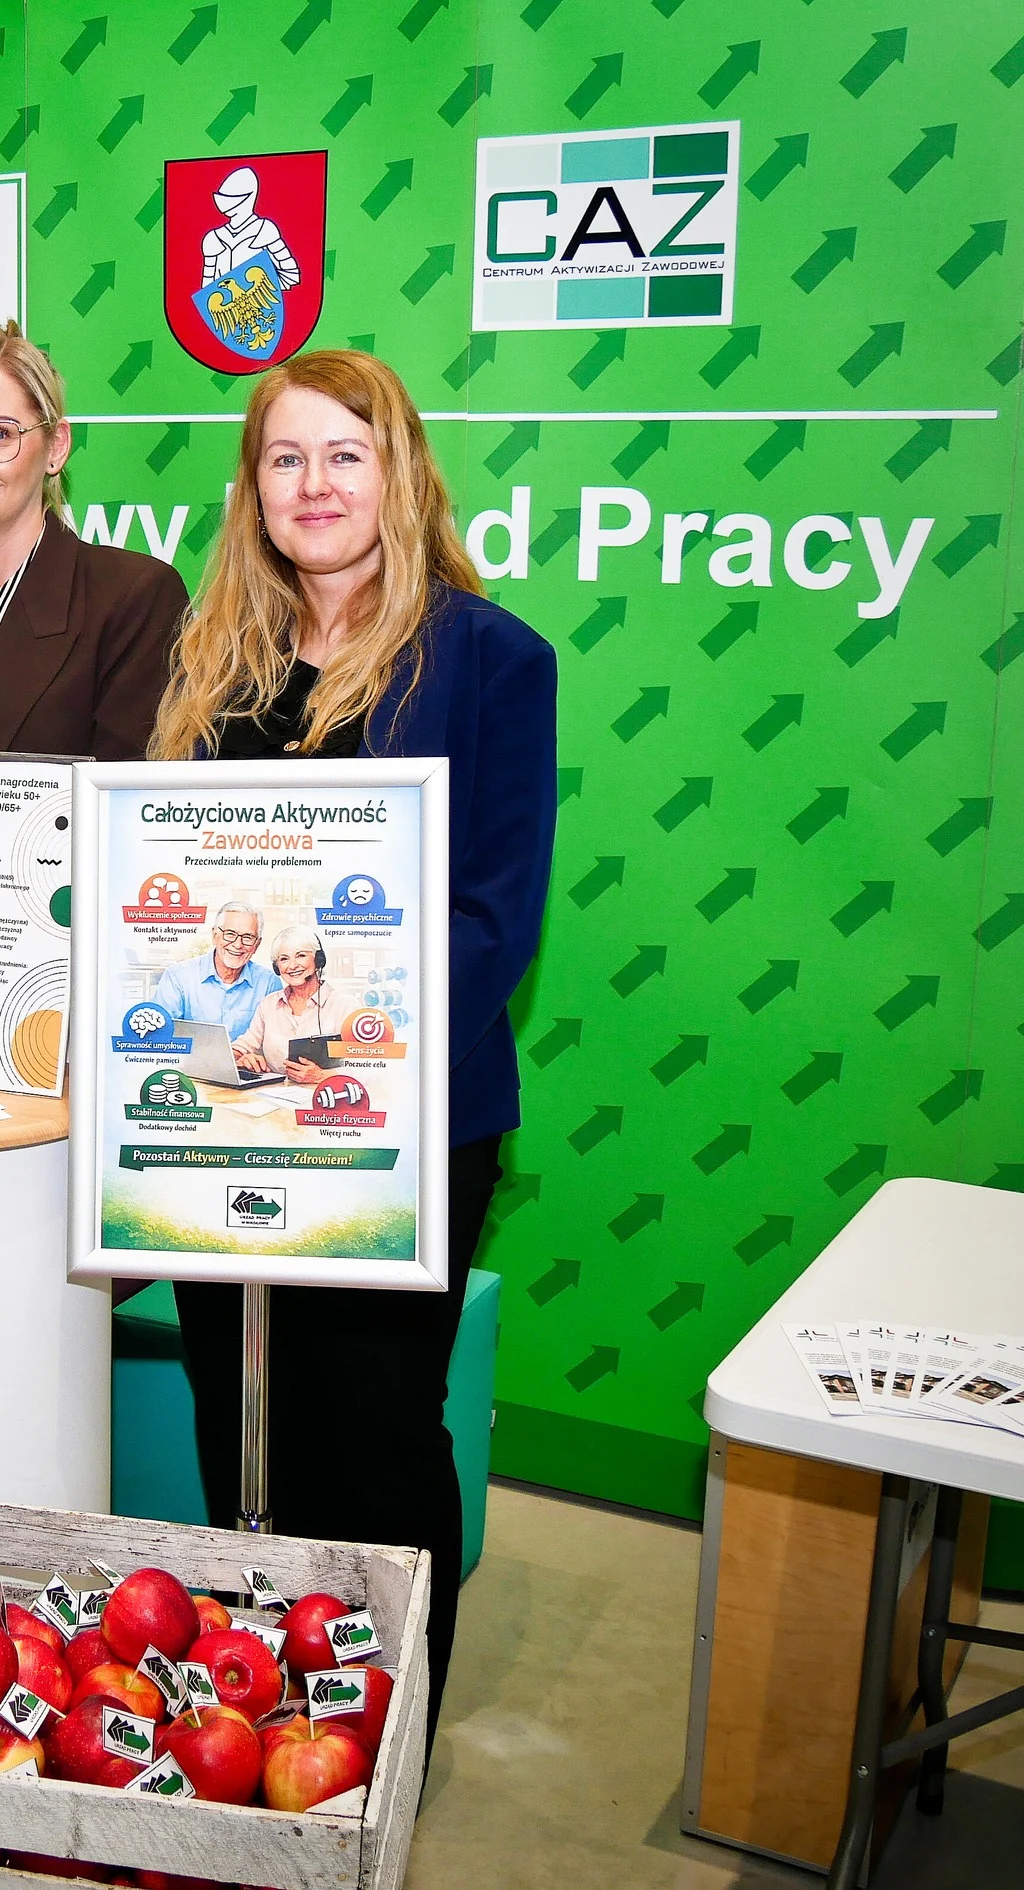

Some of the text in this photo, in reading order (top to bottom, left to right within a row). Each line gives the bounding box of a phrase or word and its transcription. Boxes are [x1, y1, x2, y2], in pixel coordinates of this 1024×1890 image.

[486, 179, 725, 263] CAZ
[577, 486, 936, 619] Pracy
[23, 791, 40, 800] 50+
[140, 799, 387, 830] Całożyciowa Aktywność
[202, 829, 314, 850] Zawodowa
[184, 856, 322, 868] Przeciwdziała wielu problemom
[126, 910, 202, 921] Wykluczenie społeczne
[320, 912, 393, 924] Zdrowie psychiczne
[133, 926, 158, 934] Kontakt
[164, 926, 198, 936] aktywność
[347, 929, 392, 938] samopoczucie
[148, 934, 178, 944] społeczna
[116, 1040, 187, 1052] Sprawność umysłowa
[346, 1046, 385, 1057] Sens życia
[124, 1054, 180, 1065] Ćwiczenie pamięci
[344, 1060, 386, 1068] Poczucie celu
[130, 1107, 205, 1118] Stabilność finansowa
[304, 1113, 376, 1126] Kondycja fizyczna
[138, 1123, 197, 1132] Dodatkowy dochód
[320, 1128, 362, 1138] Więcej ruchu
[132, 1150, 181, 1162] Pozostań
[182, 1151, 230, 1166] Aktywny
[244, 1152, 272, 1164] Ciesz
[274, 1152, 290, 1167] się
[292, 1152, 353, 1166] Zdrowiem!
